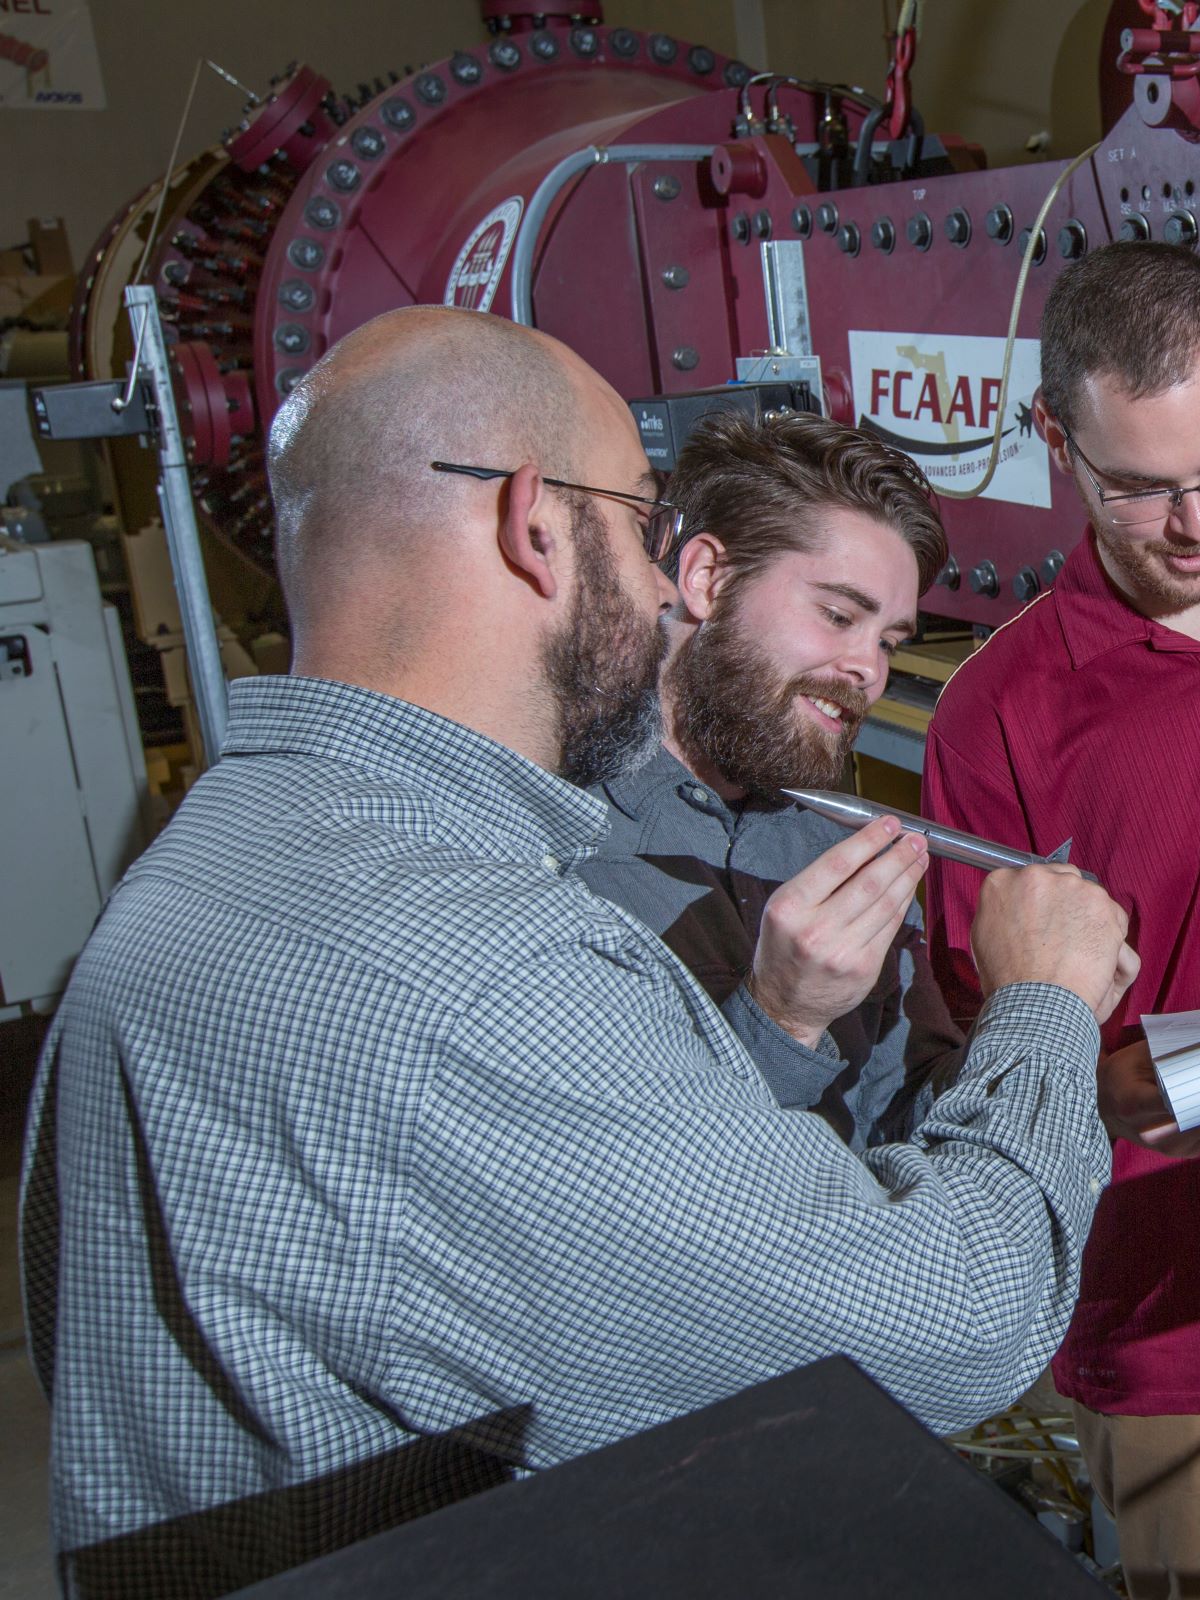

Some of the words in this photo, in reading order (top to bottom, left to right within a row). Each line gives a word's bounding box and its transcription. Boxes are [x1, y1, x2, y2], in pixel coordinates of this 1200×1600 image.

[1107, 148, 1125, 162] SET
[1129, 146, 1137, 160] A
[912, 188, 926, 201] TOP
[870, 368, 1002, 428] FCAAP
[924, 464, 957, 478] ADVANCED
[959, 441, 1020, 475] AERO-PROLSION
